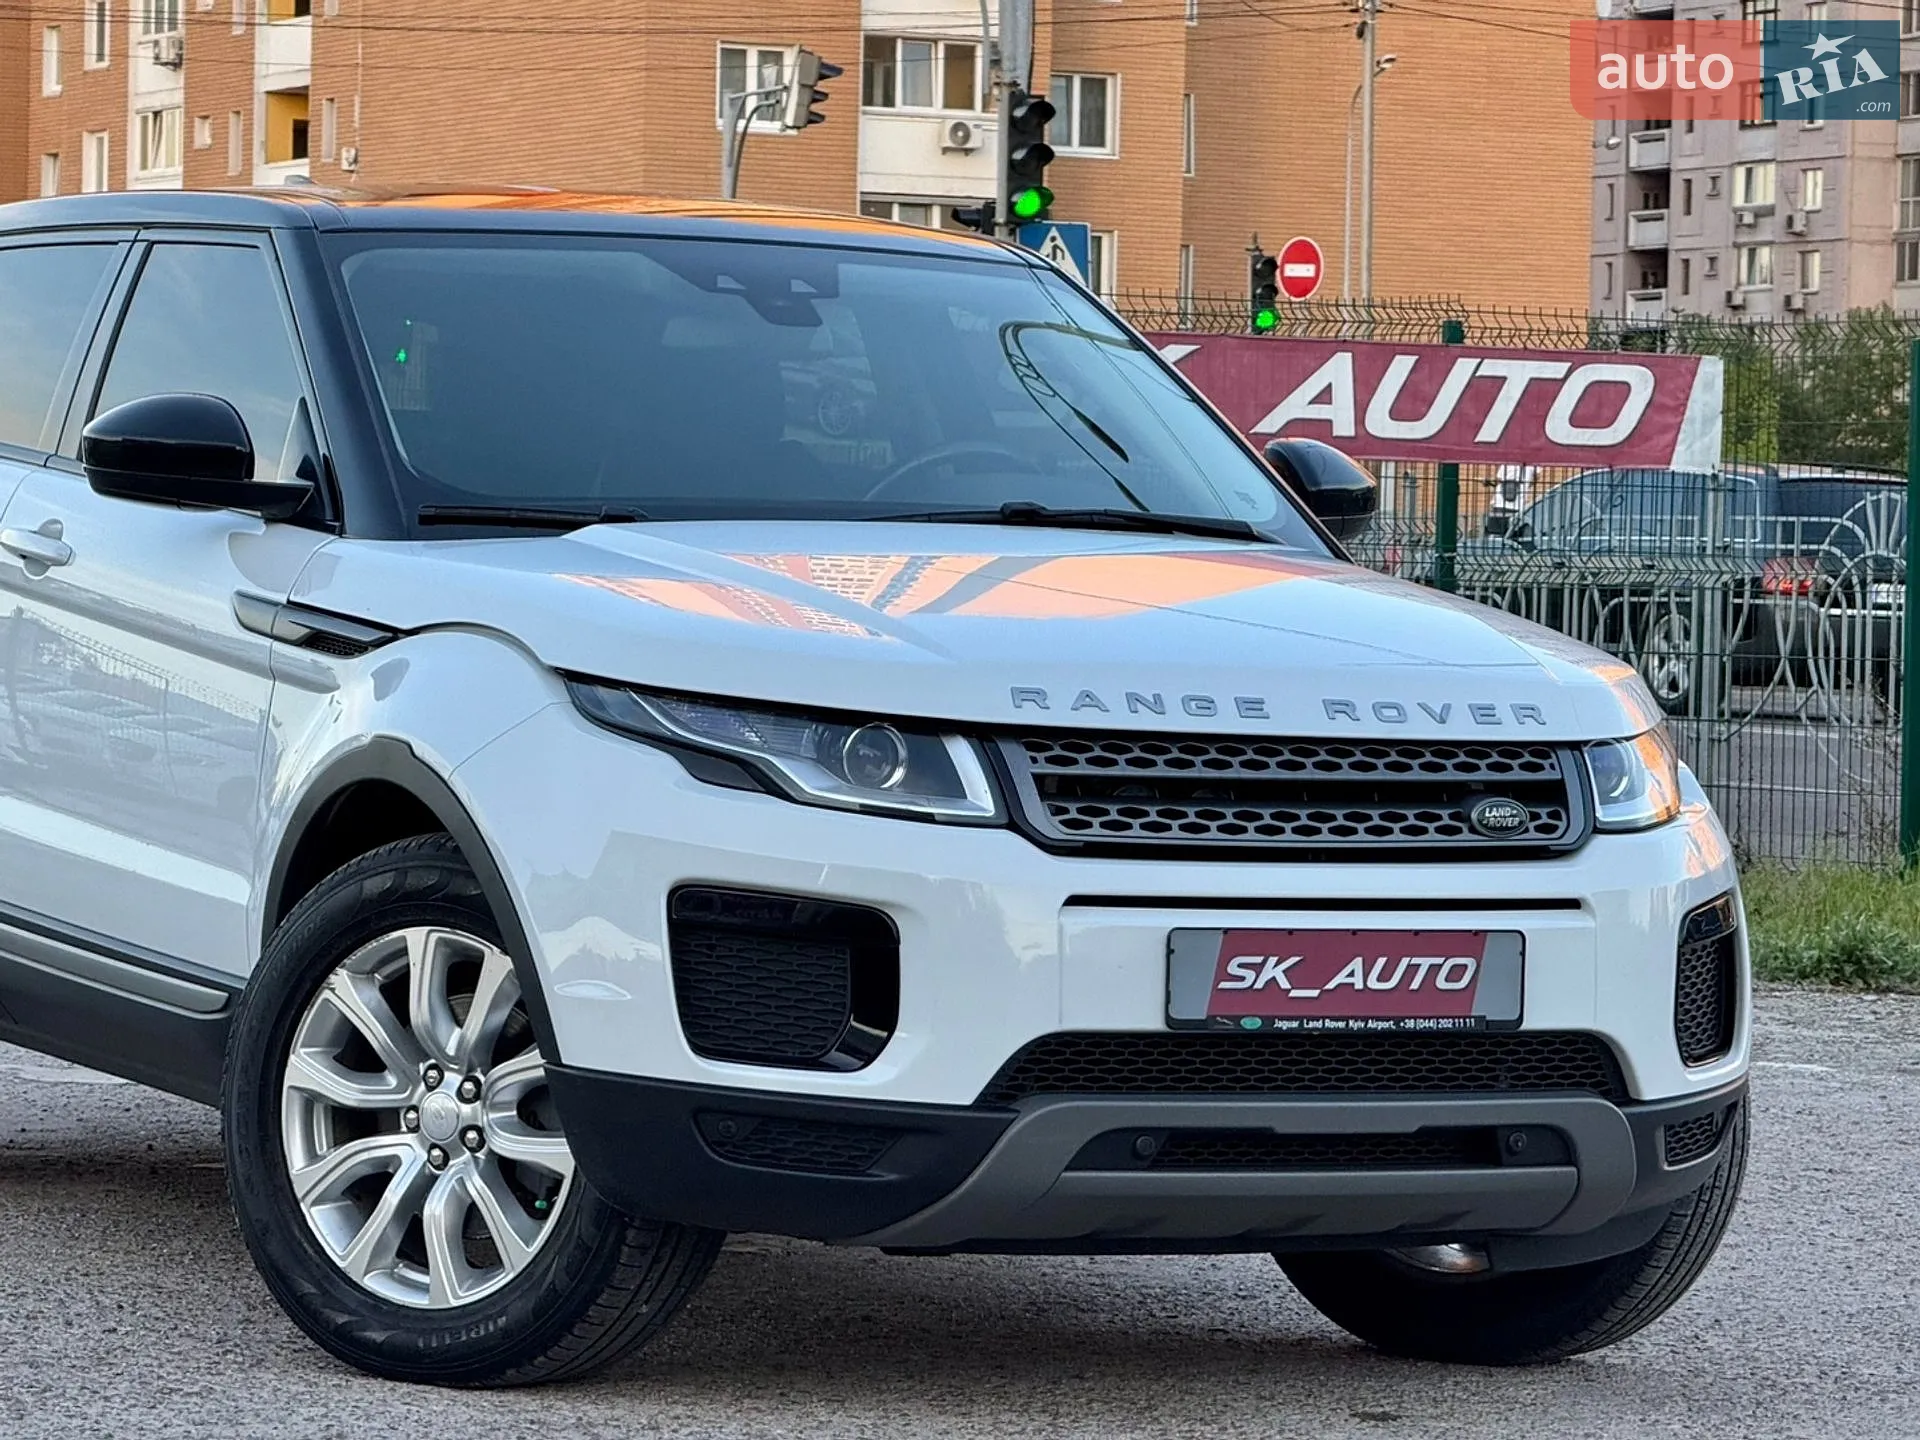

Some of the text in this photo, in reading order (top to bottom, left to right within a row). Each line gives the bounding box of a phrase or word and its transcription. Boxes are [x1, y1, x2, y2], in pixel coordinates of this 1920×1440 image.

[1009, 686, 1548, 727] RANGE ROVER
[1217, 955, 1477, 998] SK_AUTO
[1273, 1018, 1300, 1030] Jaguar
[1303, 1018, 1324, 1029] Land
[1324, 1018, 1347, 1029] Rover
[1348, 1019, 1365, 1031] Kyiv
[1400, 1018, 1415, 1028] +38
[1416, 1018, 1437, 1031] (044)
[1438, 1018, 1454, 1029] 202
